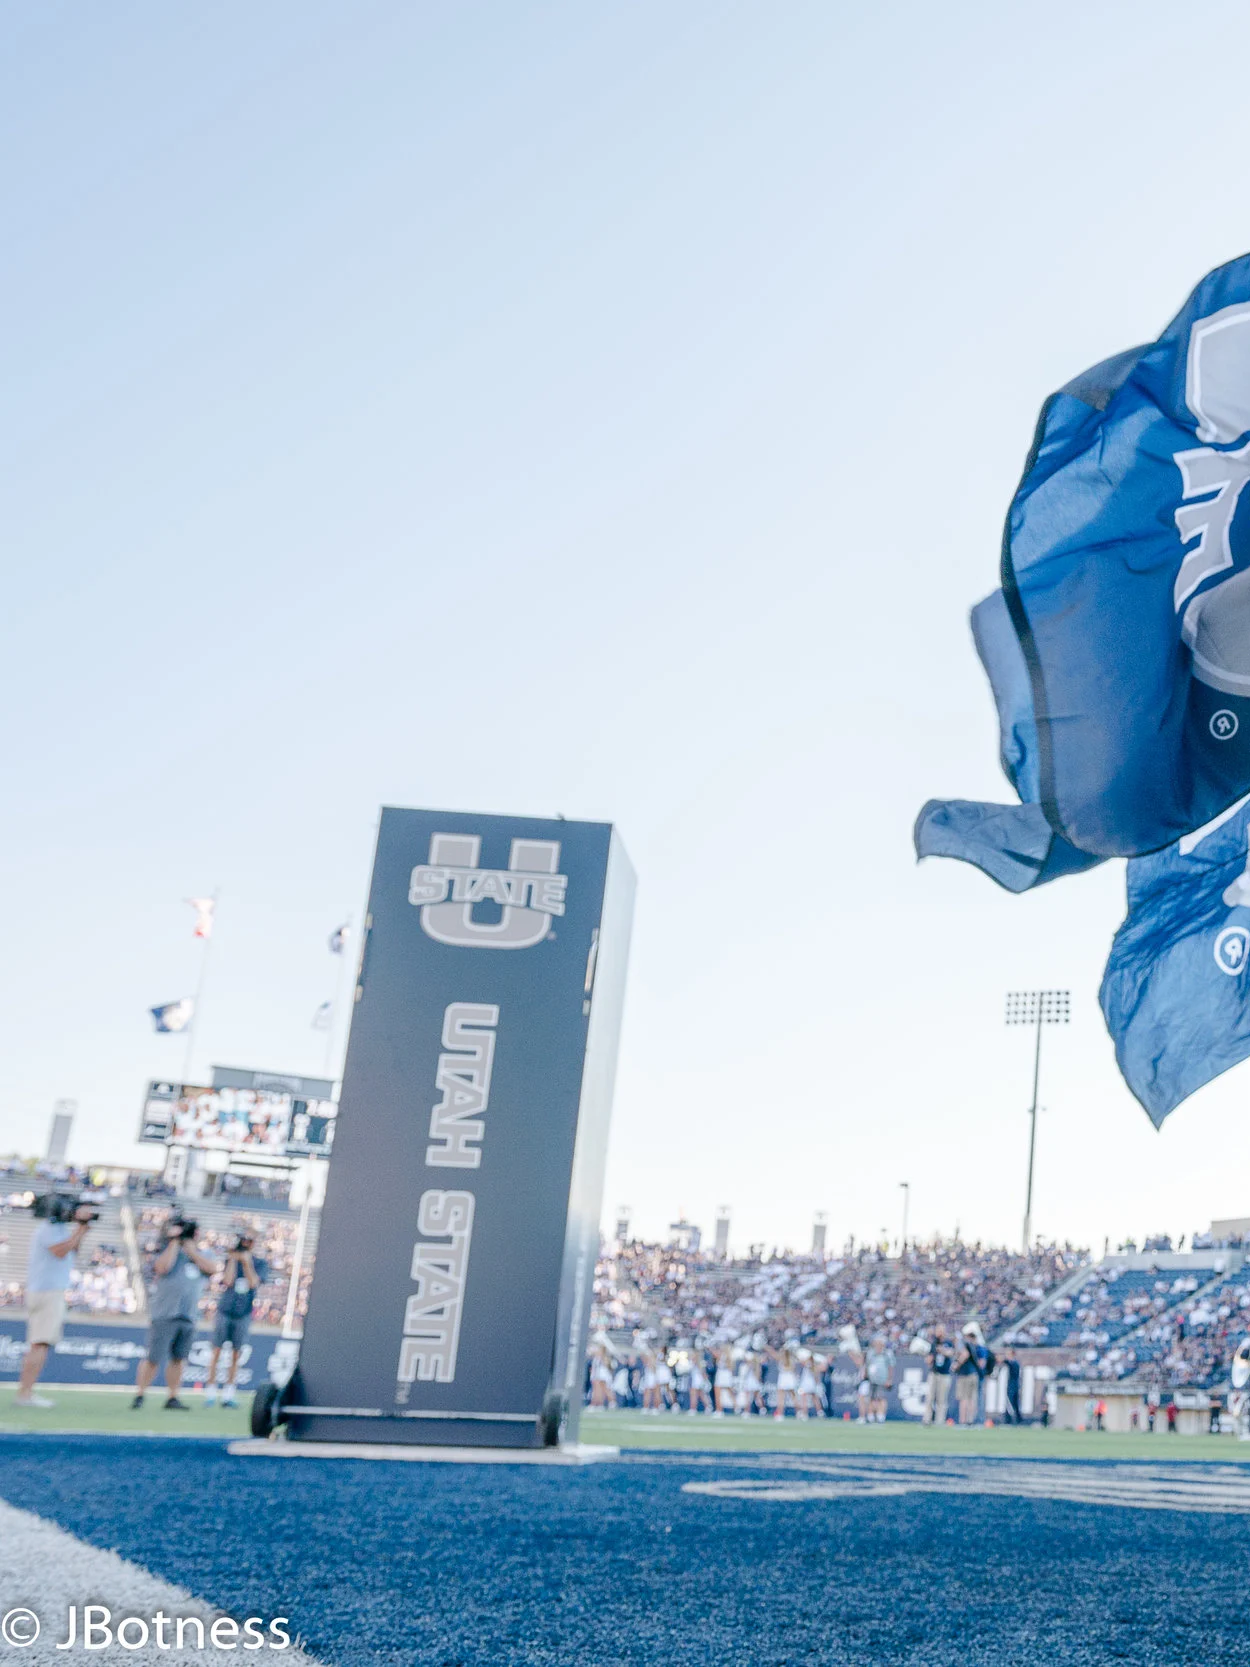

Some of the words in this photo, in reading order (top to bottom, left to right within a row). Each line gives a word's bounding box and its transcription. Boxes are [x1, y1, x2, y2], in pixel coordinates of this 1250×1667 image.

[408, 864, 568, 917] STATE
[425, 1002, 500, 1169] UTAH
[397, 1188, 476, 1382] STATE
